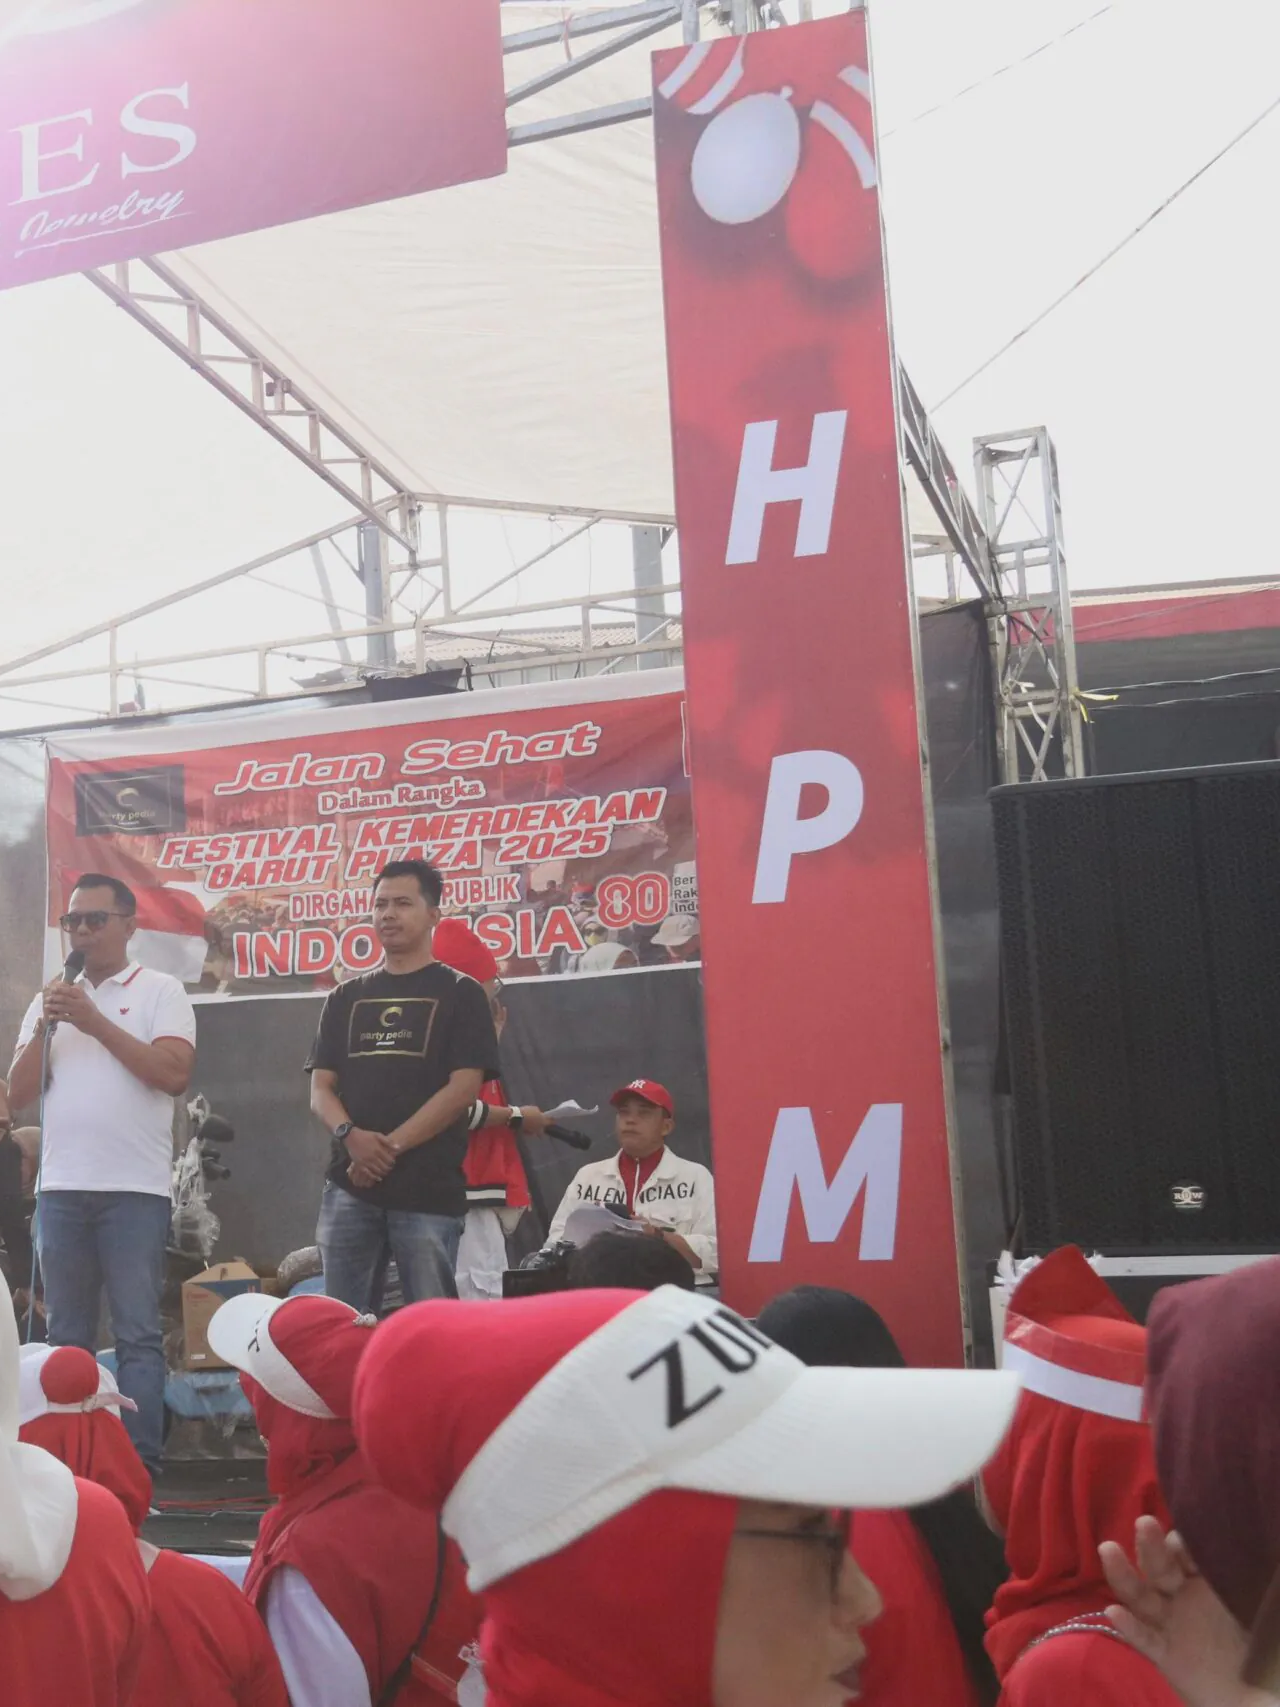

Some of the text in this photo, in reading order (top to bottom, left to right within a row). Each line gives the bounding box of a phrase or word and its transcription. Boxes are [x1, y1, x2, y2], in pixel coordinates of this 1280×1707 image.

[214, 720, 602, 796] Jalan Sehat
[157, 787, 668, 869] FESTIVAL KEMERDEKAAN
[318, 775, 486, 815] Dalam Rangka
[202, 851, 339, 893] GARUT
[494, 824, 614, 867] 2025
[595, 870, 671, 930] 80
[232, 904, 588, 980] INDOSIA
